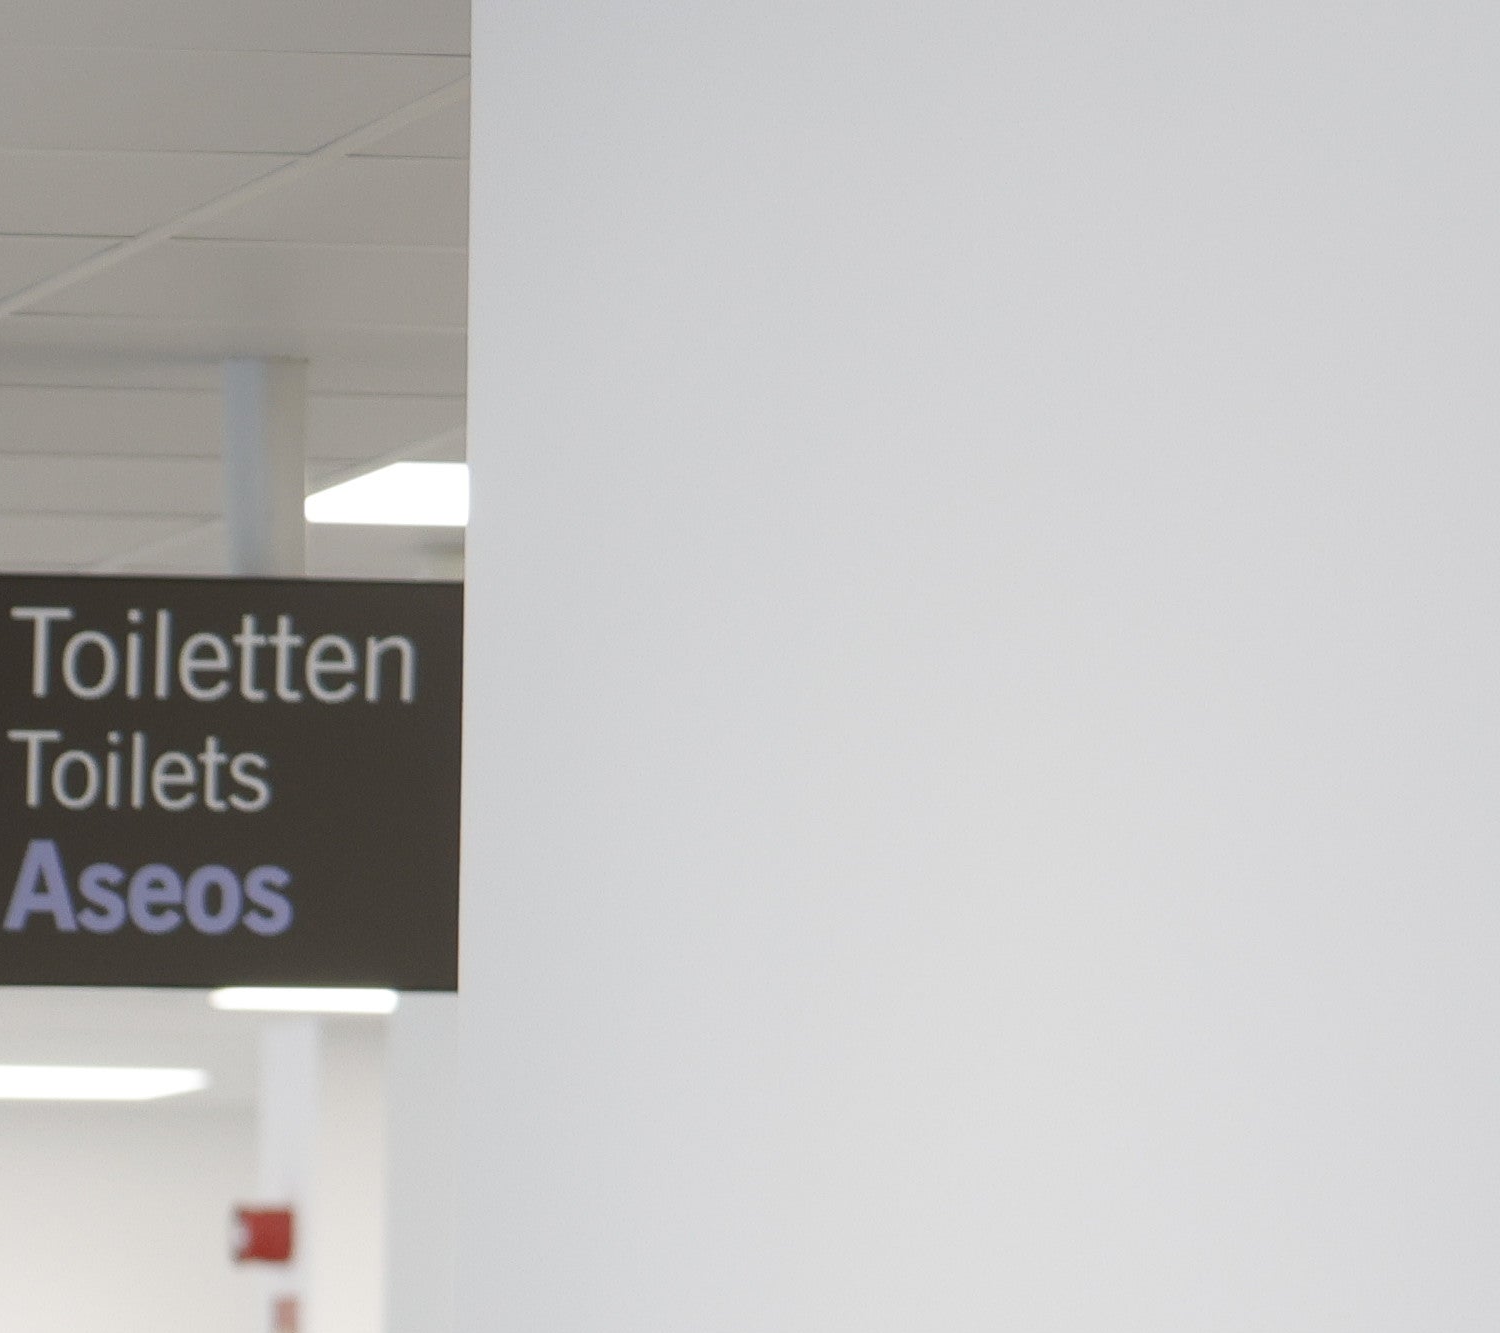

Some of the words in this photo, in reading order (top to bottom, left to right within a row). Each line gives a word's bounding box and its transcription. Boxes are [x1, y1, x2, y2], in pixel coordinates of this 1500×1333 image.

[9, 605, 417, 705] Toiletten
[6, 728, 272, 813] Toilets
[3, 838, 295, 937] Aseos
